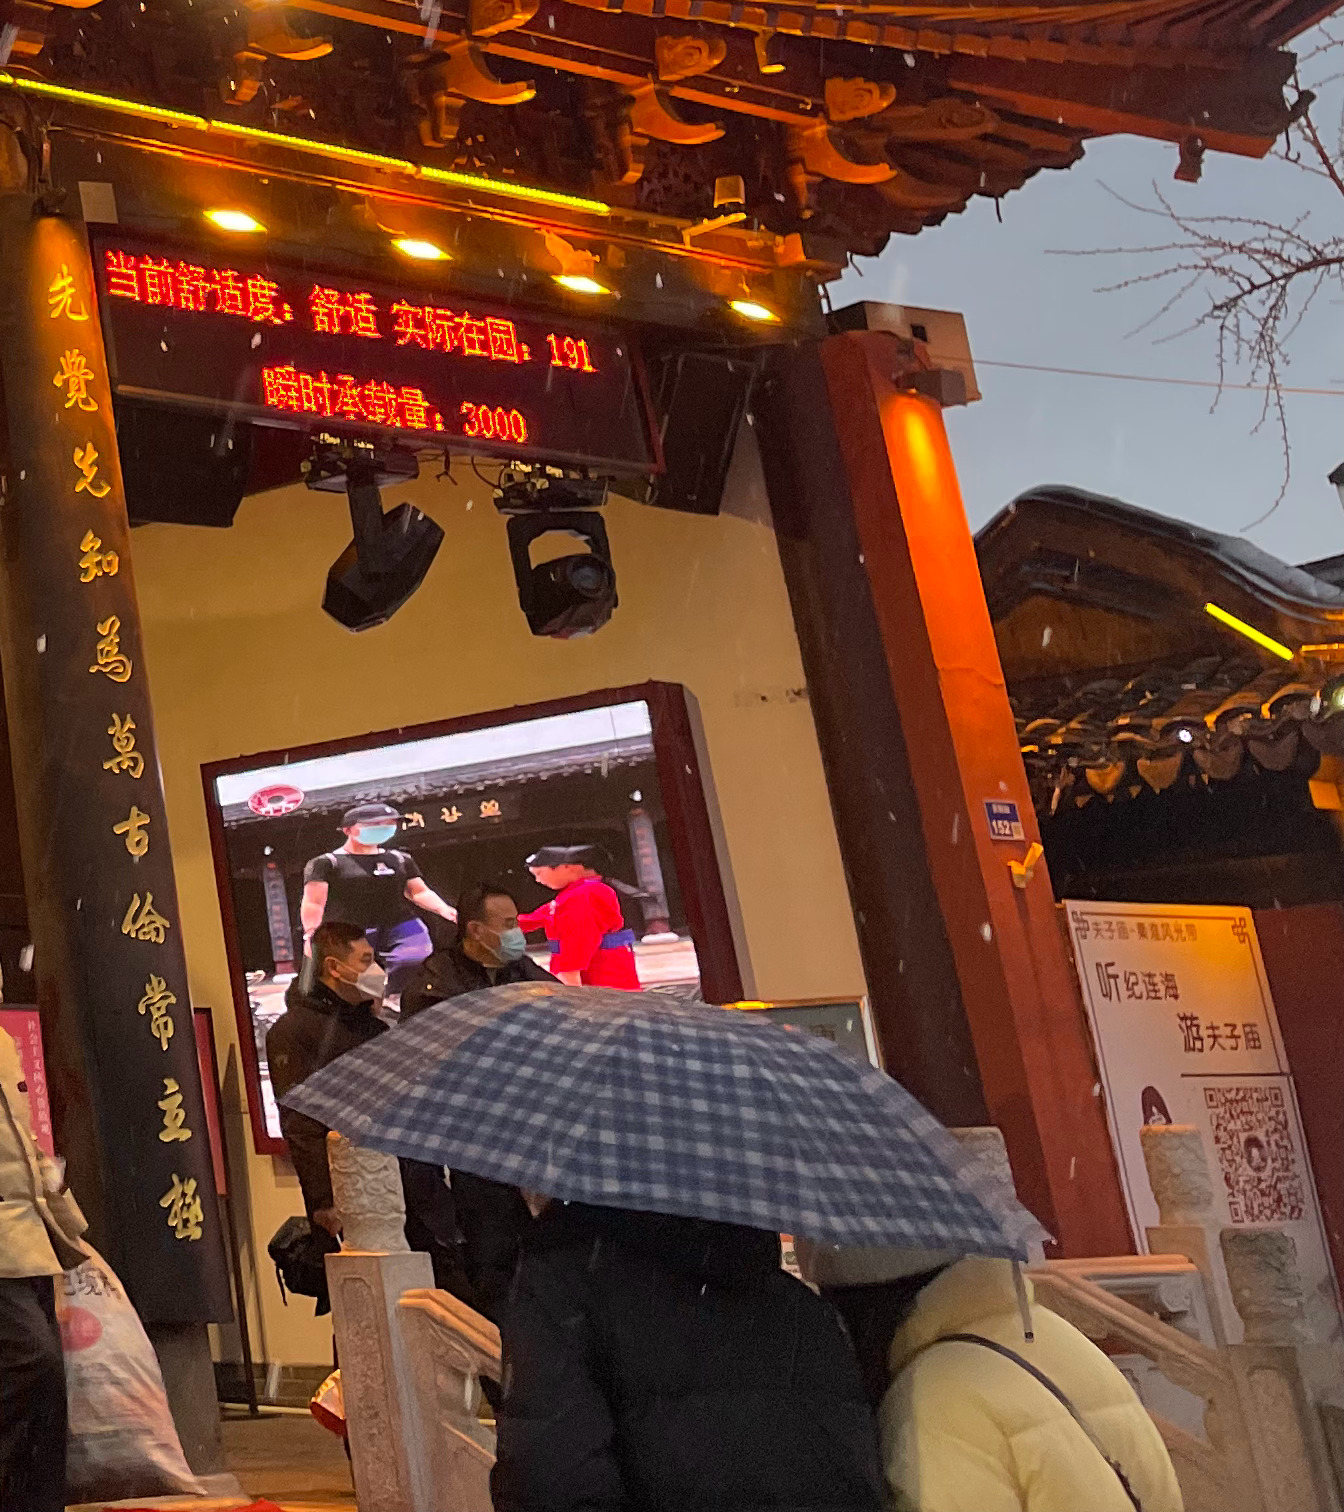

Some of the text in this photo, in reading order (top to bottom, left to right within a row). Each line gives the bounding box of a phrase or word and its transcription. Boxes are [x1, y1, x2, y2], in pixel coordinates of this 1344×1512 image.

[1095, 961, 1180, 1003] 听纪连海
[1176, 1012, 1262, 1053] 游夫子庙
